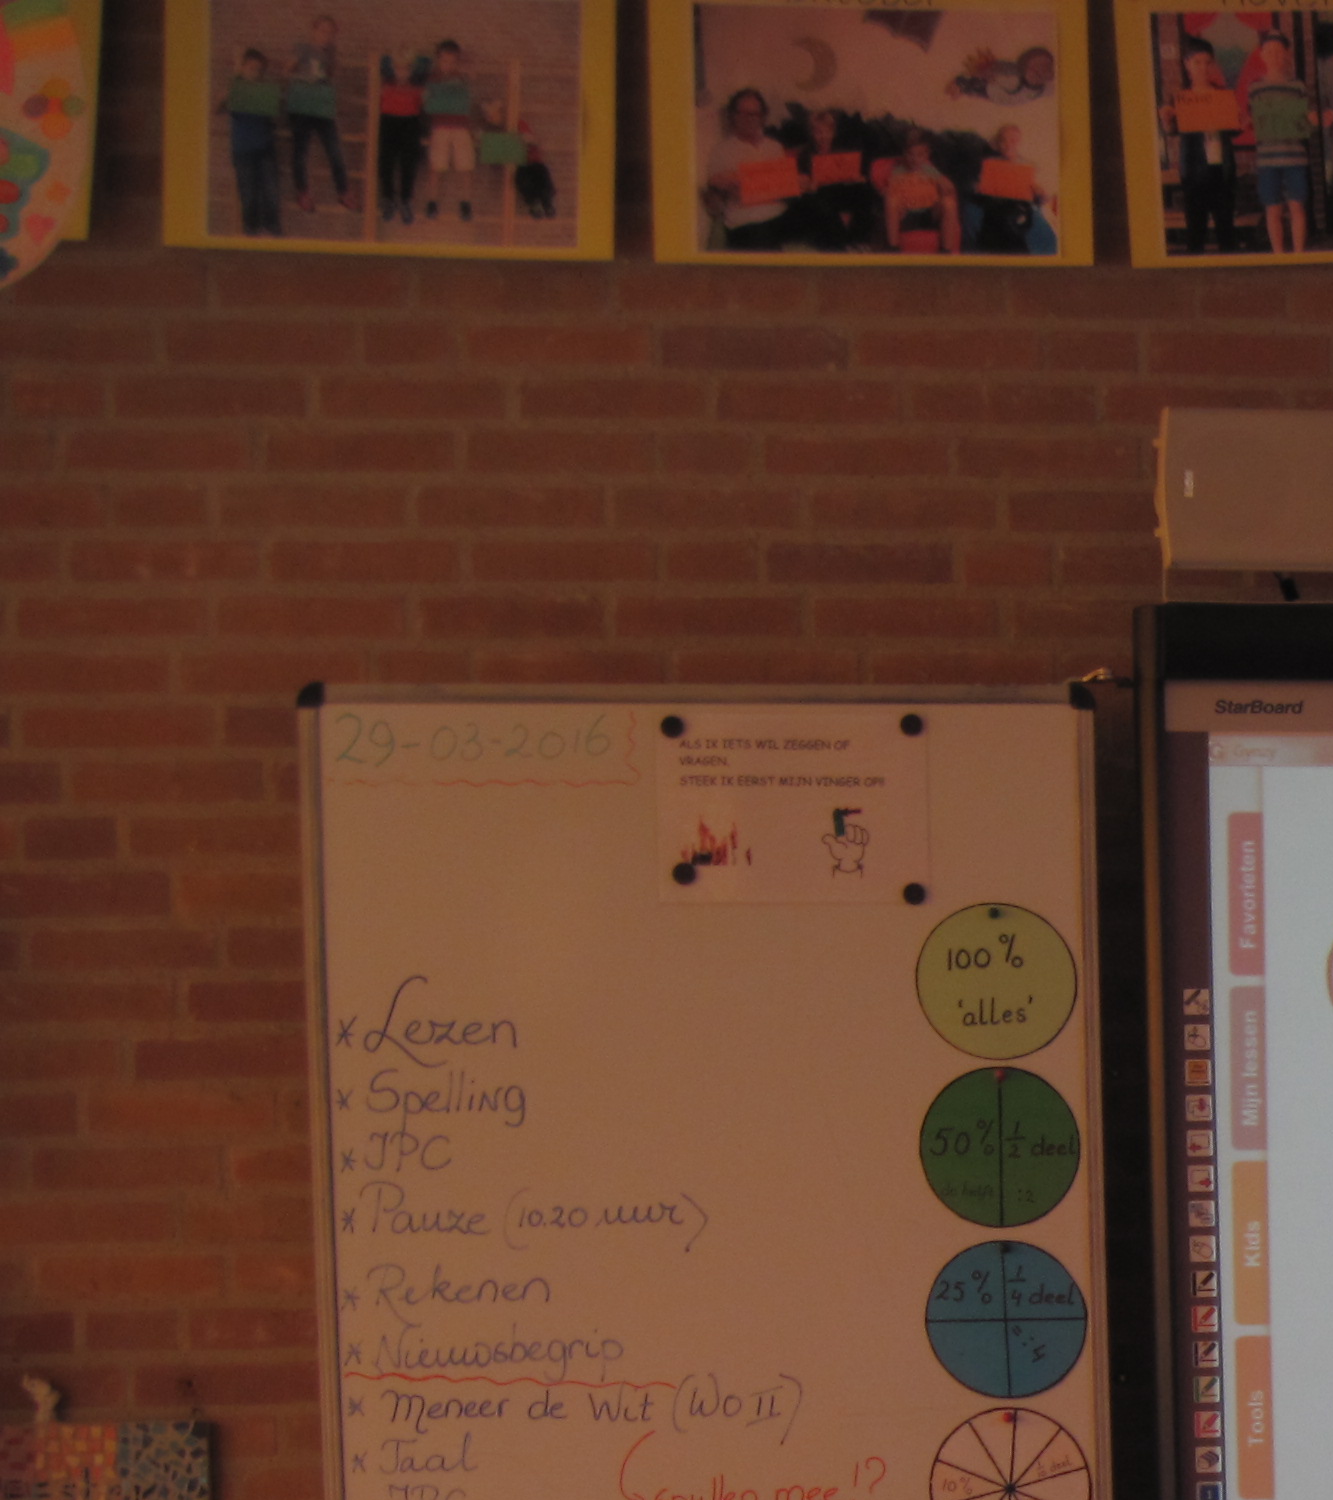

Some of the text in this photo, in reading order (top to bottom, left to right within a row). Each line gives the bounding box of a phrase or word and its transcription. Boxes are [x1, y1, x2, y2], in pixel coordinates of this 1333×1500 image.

[1213, 699, 1306, 716] StarBoard
[334, 711, 613, 770] 29-03-2016
[723, 738, 752, 750] IETS
[755, 738, 779, 750] WIL
[783, 738, 832, 751] ZEGGEN
[679, 774, 717, 787] STEEK
[721, 774, 734, 787] IK
[737, 774, 776, 787] EERST
[778, 774, 812, 788] MIJN
[815, 775, 861, 788] VINGER
[1239, 840, 1257, 949] Favorieten
[363, 974, 520, 1069] Lezen
[1242, 1008, 1258, 1073] lessen
[366, 1068, 528, 1128] Spelling
[360, 1181, 491, 1237] Pauze
[1243, 1219, 1261, 1268] Kids
[366, 1263, 553, 1325] Rekenen
[373, 1323, 626, 1384] Nieuwsbegrip
[380, 1389, 511, 1434] Meneer
[527, 1388, 569, 1423] de
[1247, 1389, 1265, 1446] Tools
[379, 1431, 480, 1475] Taal
